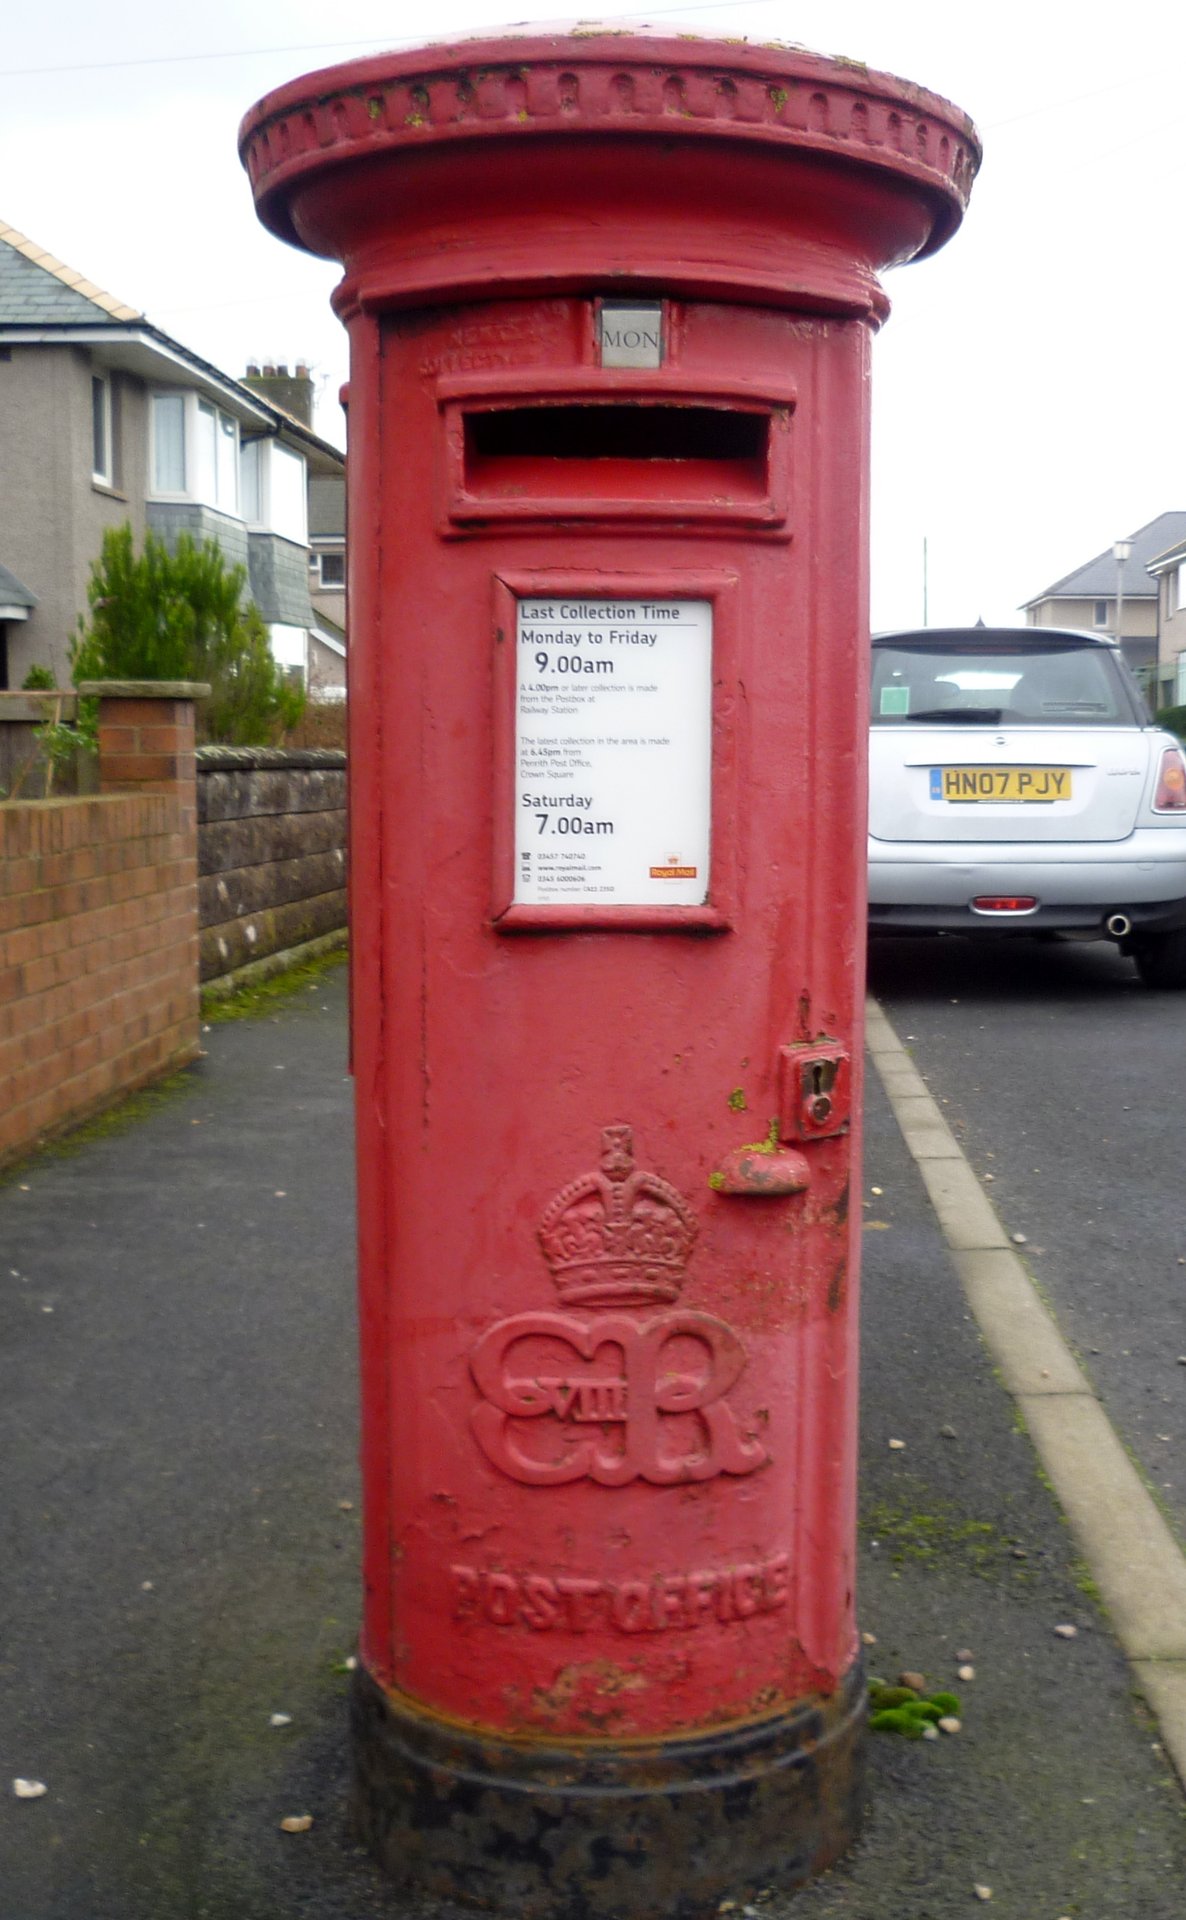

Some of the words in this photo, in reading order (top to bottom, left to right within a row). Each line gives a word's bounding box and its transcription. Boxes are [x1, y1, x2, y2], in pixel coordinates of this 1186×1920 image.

[604, 330, 658, 348] MON
[521, 605, 554, 619] Last
[560, 605, 635, 619] Collection
[641, 605, 680, 619] Time
[521, 630, 581, 646] Monday
[588, 631, 602, 644] to
[610, 630, 657, 646] Friday
[535, 652, 613, 673] 9.00am
[529, 684, 558, 693] 4.00pm
[521, 737, 535, 745] The
[538, 737, 558, 745] latest
[560, 737, 594, 745] collection
[607, 737, 619, 745] the
[648, 737, 669, 745] made
[531, 749, 560, 757] 6.45pm
[521, 759, 547, 767] Penrith
[551, 759, 567, 767] Post
[570, 759, 592, 767] Office,
[547, 771, 574, 779] Square
[945, 772, 1010, 795] HN07
[1018, 772, 1065, 795] PJY
[522, 793, 592, 810] Saturday
[535, 814, 613, 834] 7.00am
[652, 868, 673, 877] Royal
[675, 868, 695, 876] Mail
[451, 1564, 604, 1635] POST
[608, 1551, 789, 1635] OFFICE
